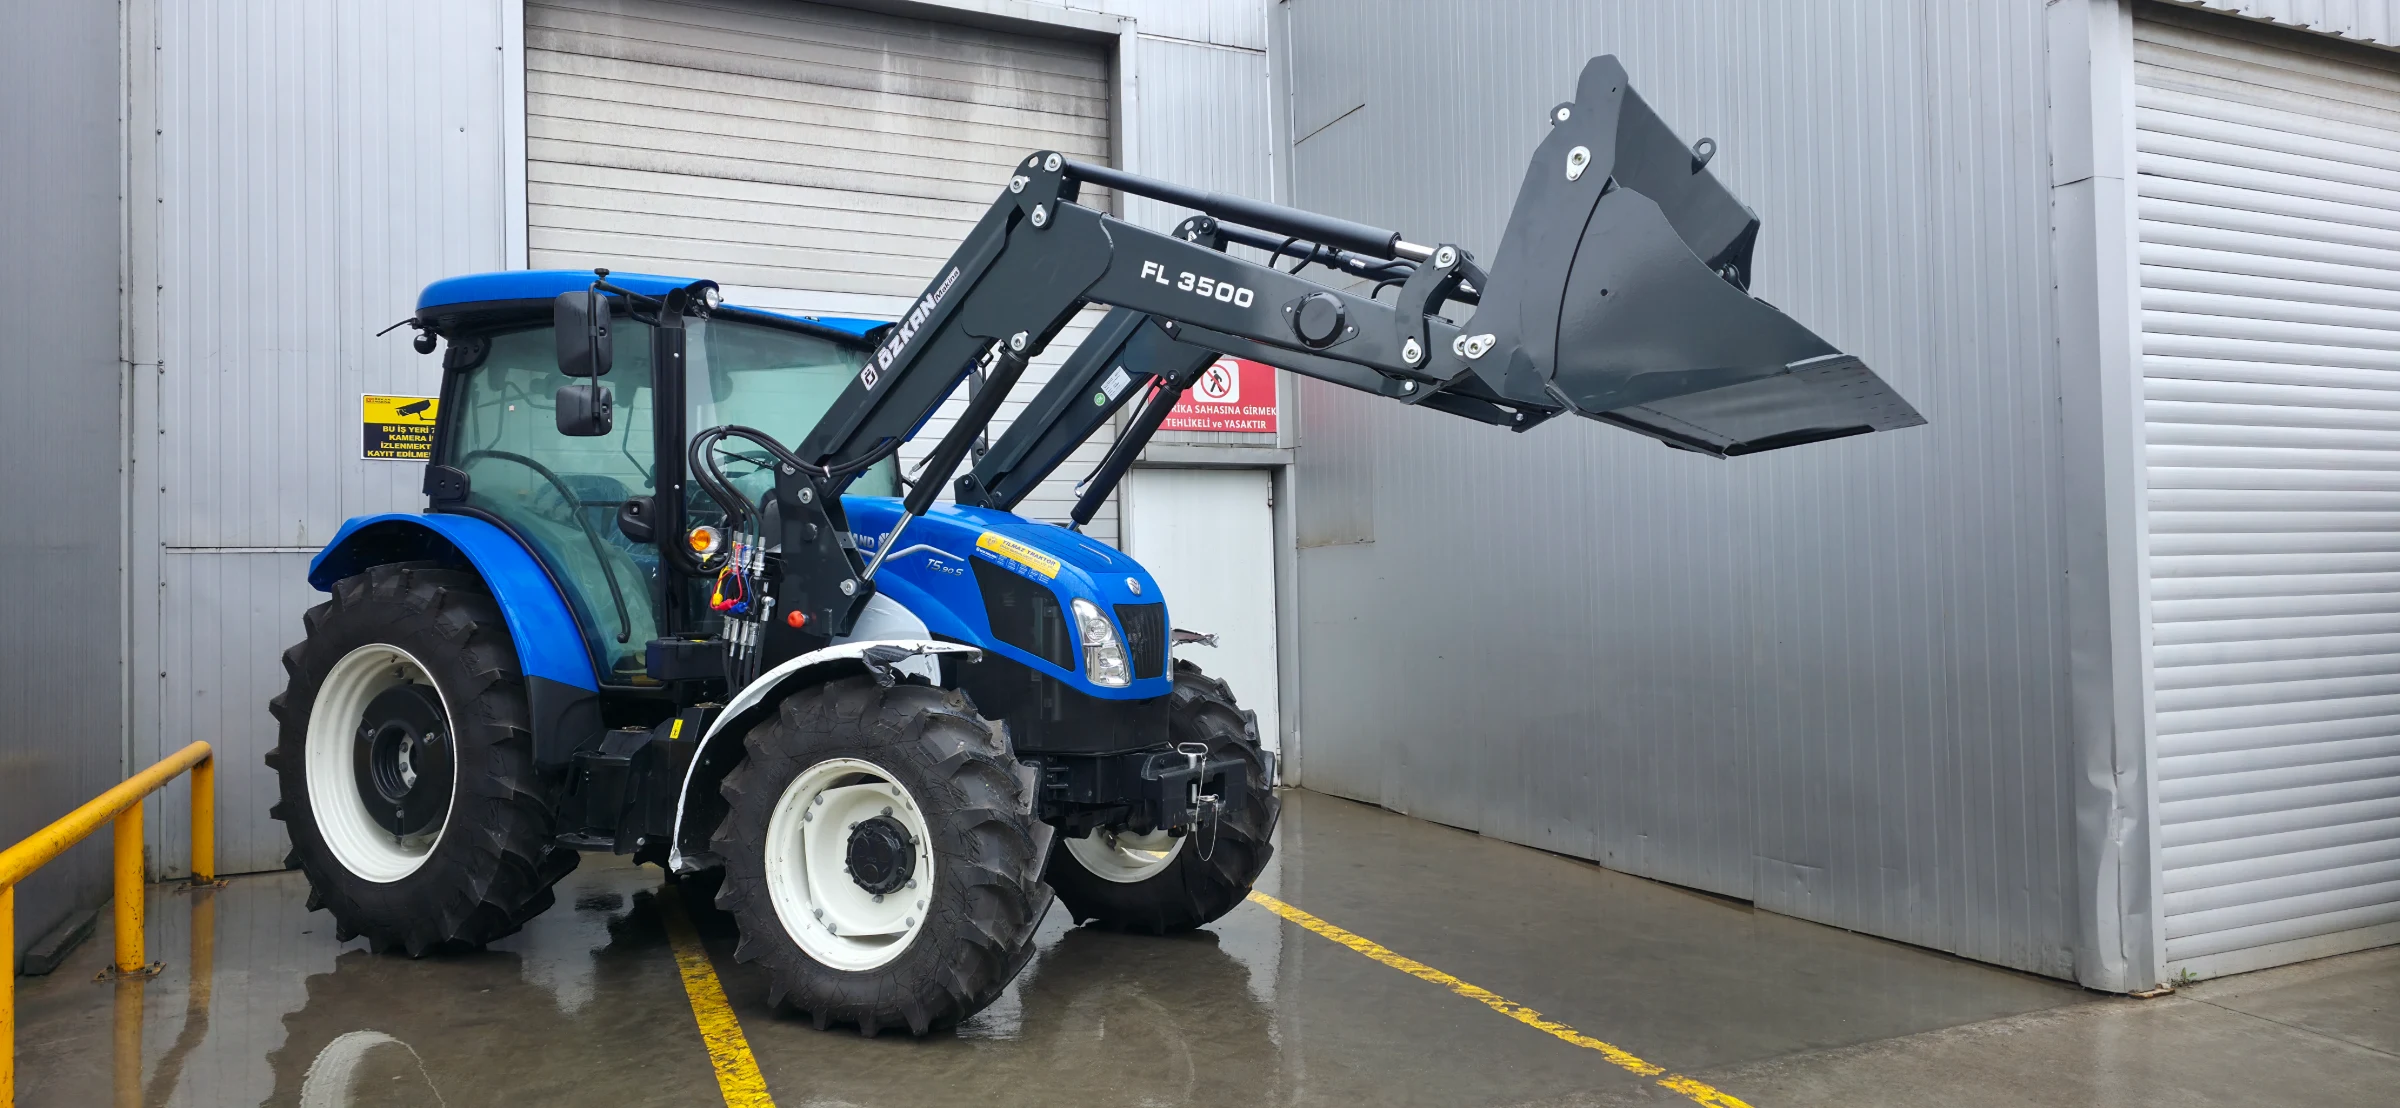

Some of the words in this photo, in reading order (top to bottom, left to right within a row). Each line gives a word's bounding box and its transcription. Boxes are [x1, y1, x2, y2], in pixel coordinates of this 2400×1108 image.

[1140, 260, 1170, 286] FL
[1177, 271, 1254, 308] 3500
[877, 292, 937, 371] ÖZKAN
[1171, 404, 1193, 414] RİKA
[1194, 405, 1241, 415] SAHASINA
[1242, 404, 1277, 416] GİRMEK
[1165, 416, 1211, 428] TEHLİKELİ
[1224, 419, 1267, 429] YASAKTIR
[382, 425, 396, 433] BU
[397, 425, 407, 434] İŞ
[408, 425, 429, 434] YERİ
[389, 434, 427, 442] KAMERA
[380, 441, 432, 450] İZLENMEKT
[396, 450, 431, 458] EDİLME
[852, 532, 875, 549] AND
